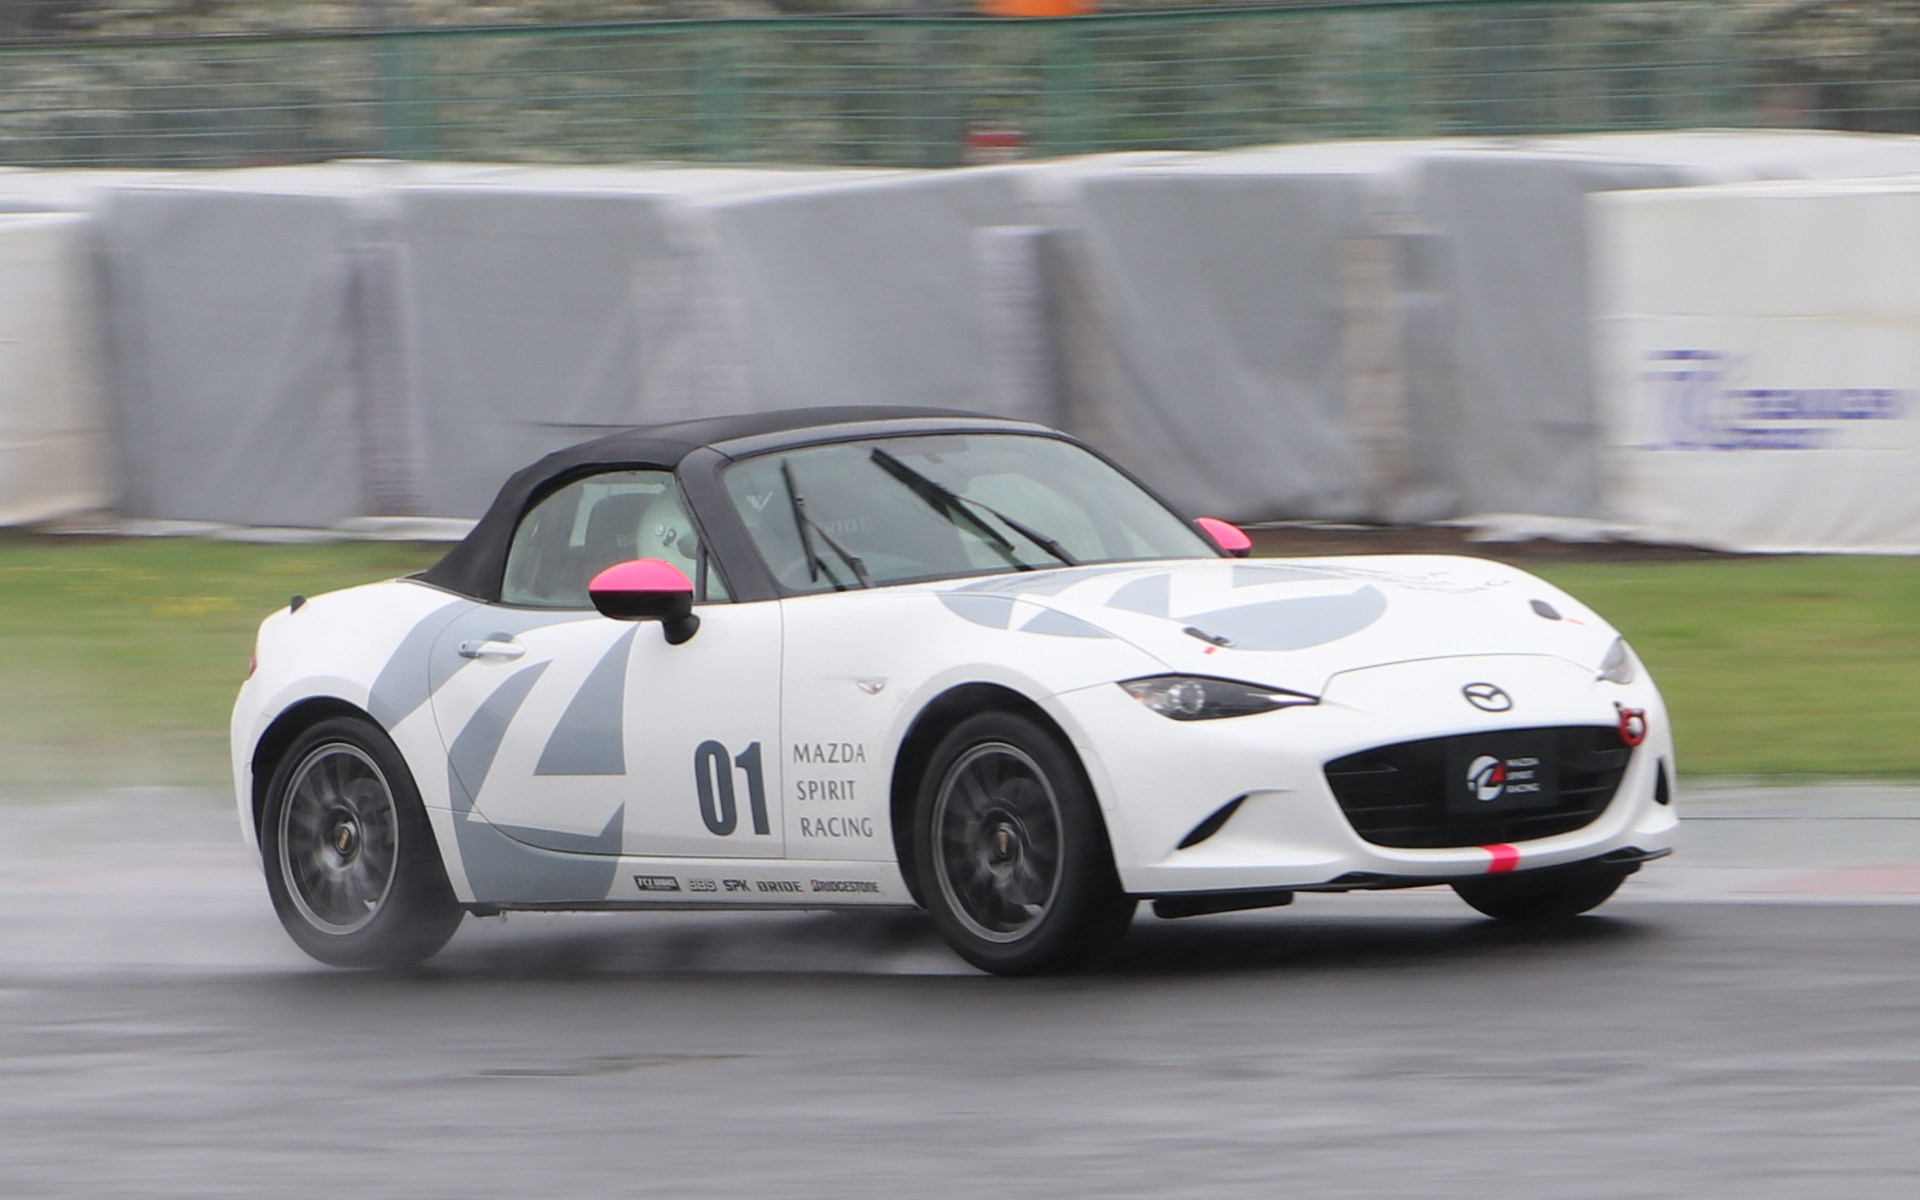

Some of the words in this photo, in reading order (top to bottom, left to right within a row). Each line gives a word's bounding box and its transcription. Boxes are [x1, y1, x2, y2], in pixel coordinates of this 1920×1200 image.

[793, 743, 867, 764] MAZDA
[694, 740, 771, 837] 01
[796, 780, 856, 801] SPIRIT
[801, 817, 874, 838] RACING
[722, 879, 752, 892] SPK
[756, 880, 804, 893] BRIDE
[810, 879, 881, 893] BRIDGESTONE
